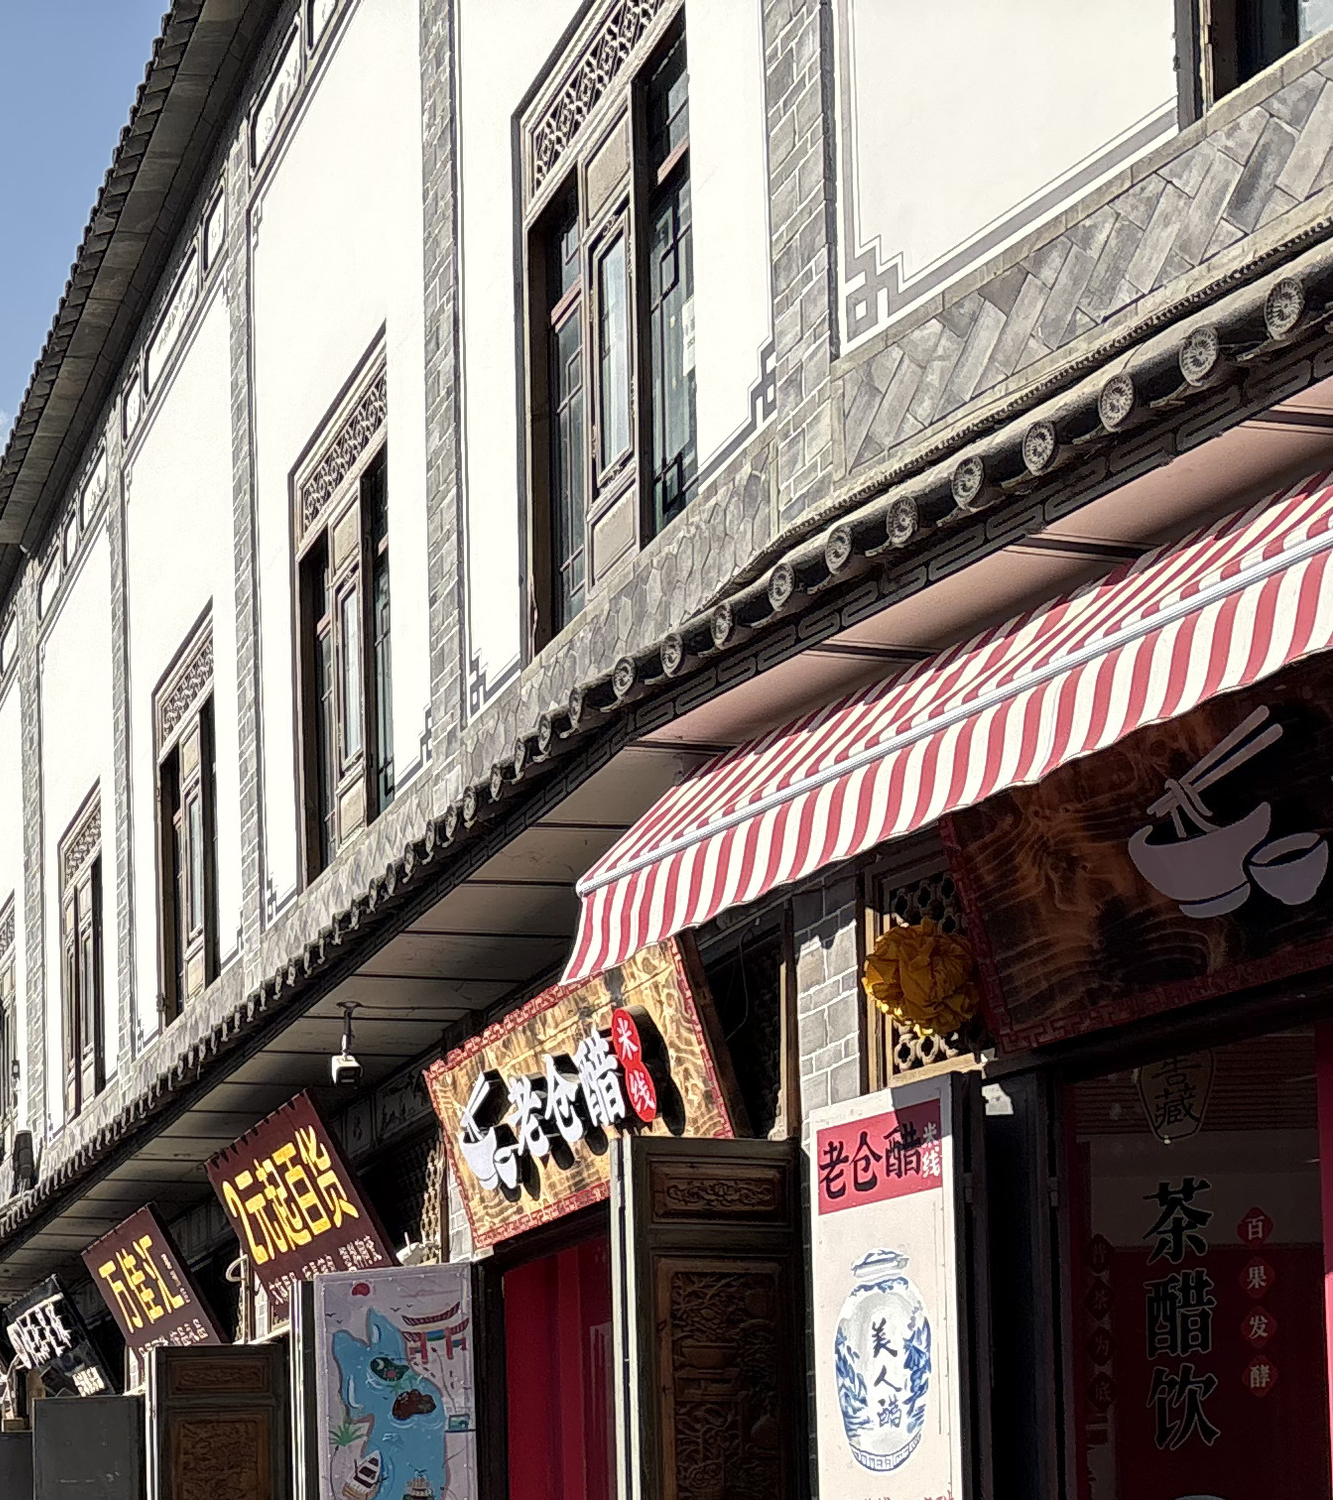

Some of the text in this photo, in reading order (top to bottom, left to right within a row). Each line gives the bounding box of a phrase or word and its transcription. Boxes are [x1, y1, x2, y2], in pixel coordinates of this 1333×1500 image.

[507, 1024, 625, 1158] 老仓醋
[616, 1017, 657, 1113] 米线
[222, 1125, 360, 1265] 2元起百货
[819, 1120, 922, 1200] 老仓醋
[98, 1234, 185, 1334] 万佳汇
[1141, 1176, 1222, 1453] 茶醋饮
[1242, 1213, 1272, 1390] 百果发酵
[870, 1316, 903, 1429] 美人醋
